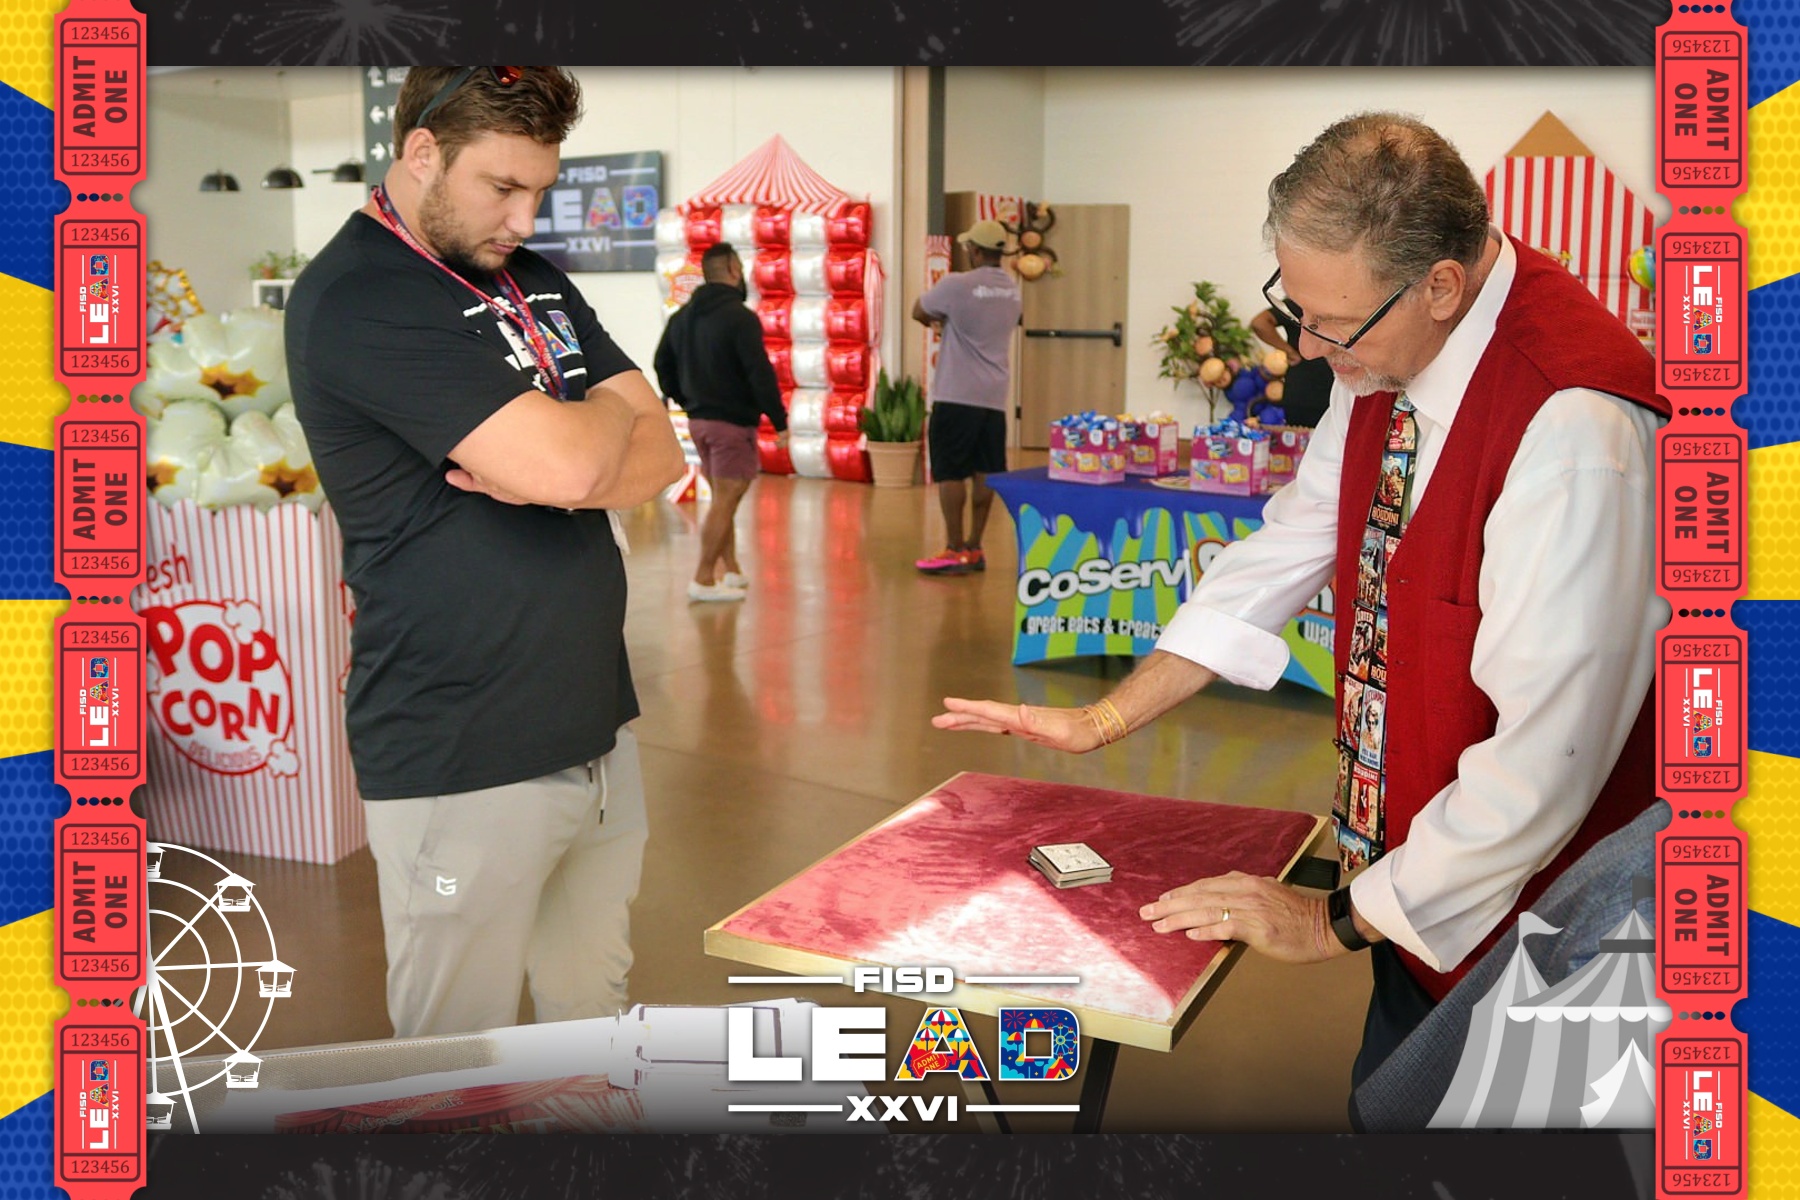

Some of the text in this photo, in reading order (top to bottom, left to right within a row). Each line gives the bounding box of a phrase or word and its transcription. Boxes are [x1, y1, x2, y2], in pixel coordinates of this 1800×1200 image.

[566, 165, 607, 184] FISD
[566, 236, 610, 254] XXVI
[137, 544, 192, 598] esh
[1018, 558, 1187, 606] CoServ
[138, 606, 277, 683] POP
[1027, 616, 1065, 636] great
[1068, 616, 1100, 635] eats
[1104, 619, 1114, 634] &
[1303, 620, 1334, 648] wa
[161, 687, 280, 742] CORN
